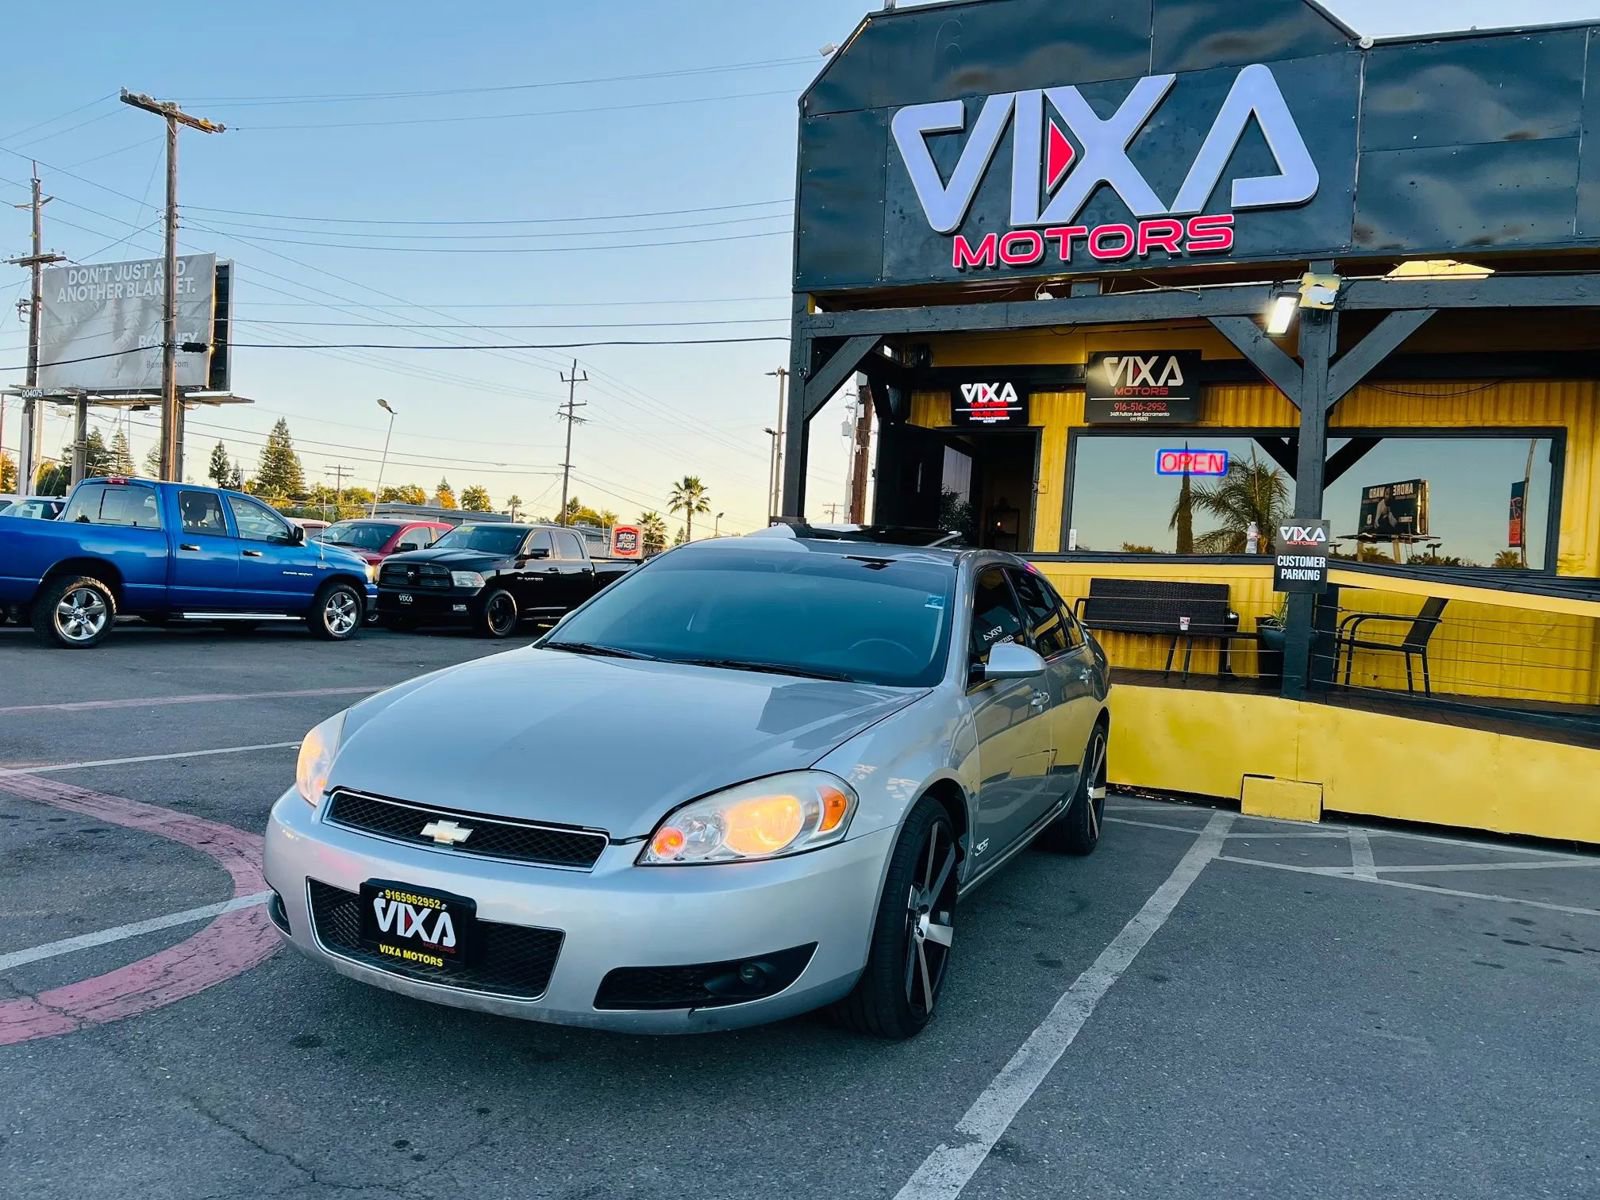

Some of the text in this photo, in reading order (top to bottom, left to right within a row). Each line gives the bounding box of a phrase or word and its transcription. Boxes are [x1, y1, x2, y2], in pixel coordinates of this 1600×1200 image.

[891, 63, 1319, 233] VIXA
[952, 215, 1235, 269] MOTORS
[68, 260, 186, 286] DON'T JUST AD
[57, 277, 196, 303] ANOTHER BLANET.
[1103, 355, 1184, 387] VIXA
[960, 382, 1018, 403] VIXA
[1114, 387, 1169, 396] MOTORS
[1162, 453, 1223, 472] OPEN
[1280, 526, 1326, 542] VIXA
[1277, 555, 1326, 568] CUSTOMER
[1281, 569, 1320, 581] PARKING
[385, 889, 441, 909] 9165962952
[373, 897, 456, 947] VIXA
[379, 943, 444, 967] VIXA MOTORS
